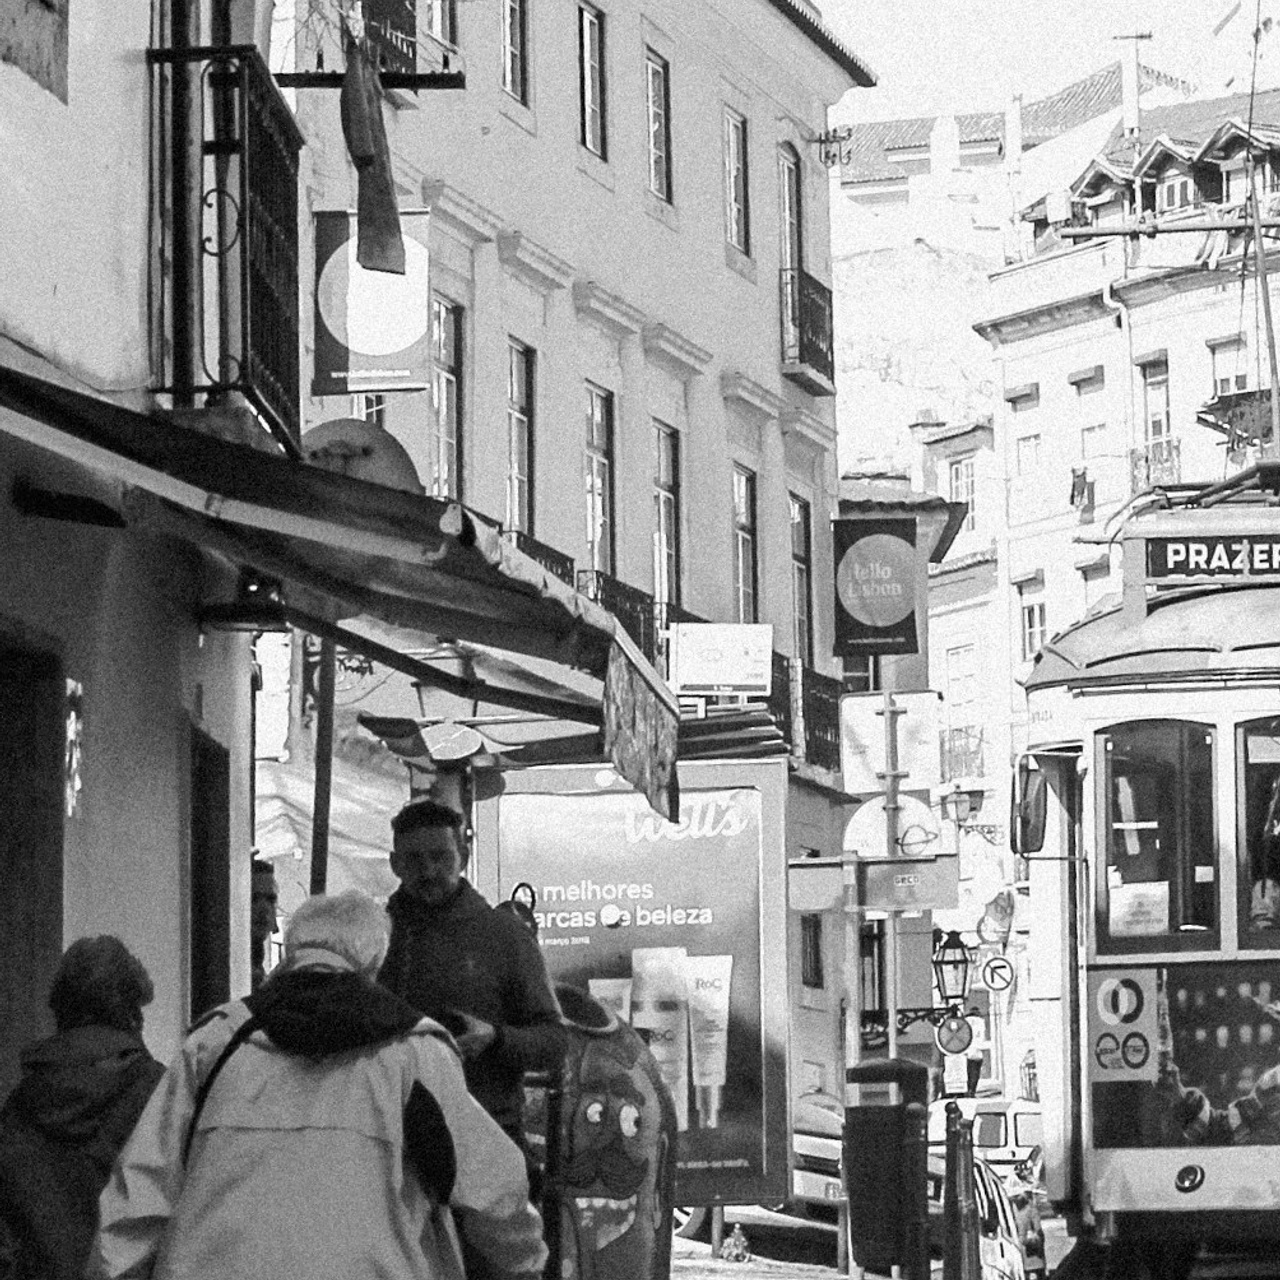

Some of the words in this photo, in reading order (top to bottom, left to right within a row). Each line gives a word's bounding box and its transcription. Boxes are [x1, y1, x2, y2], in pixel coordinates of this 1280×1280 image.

[542, 880, 654, 902] melhores
[533, 910, 597, 928] arcas
[636, 904, 713, 926] beleza
